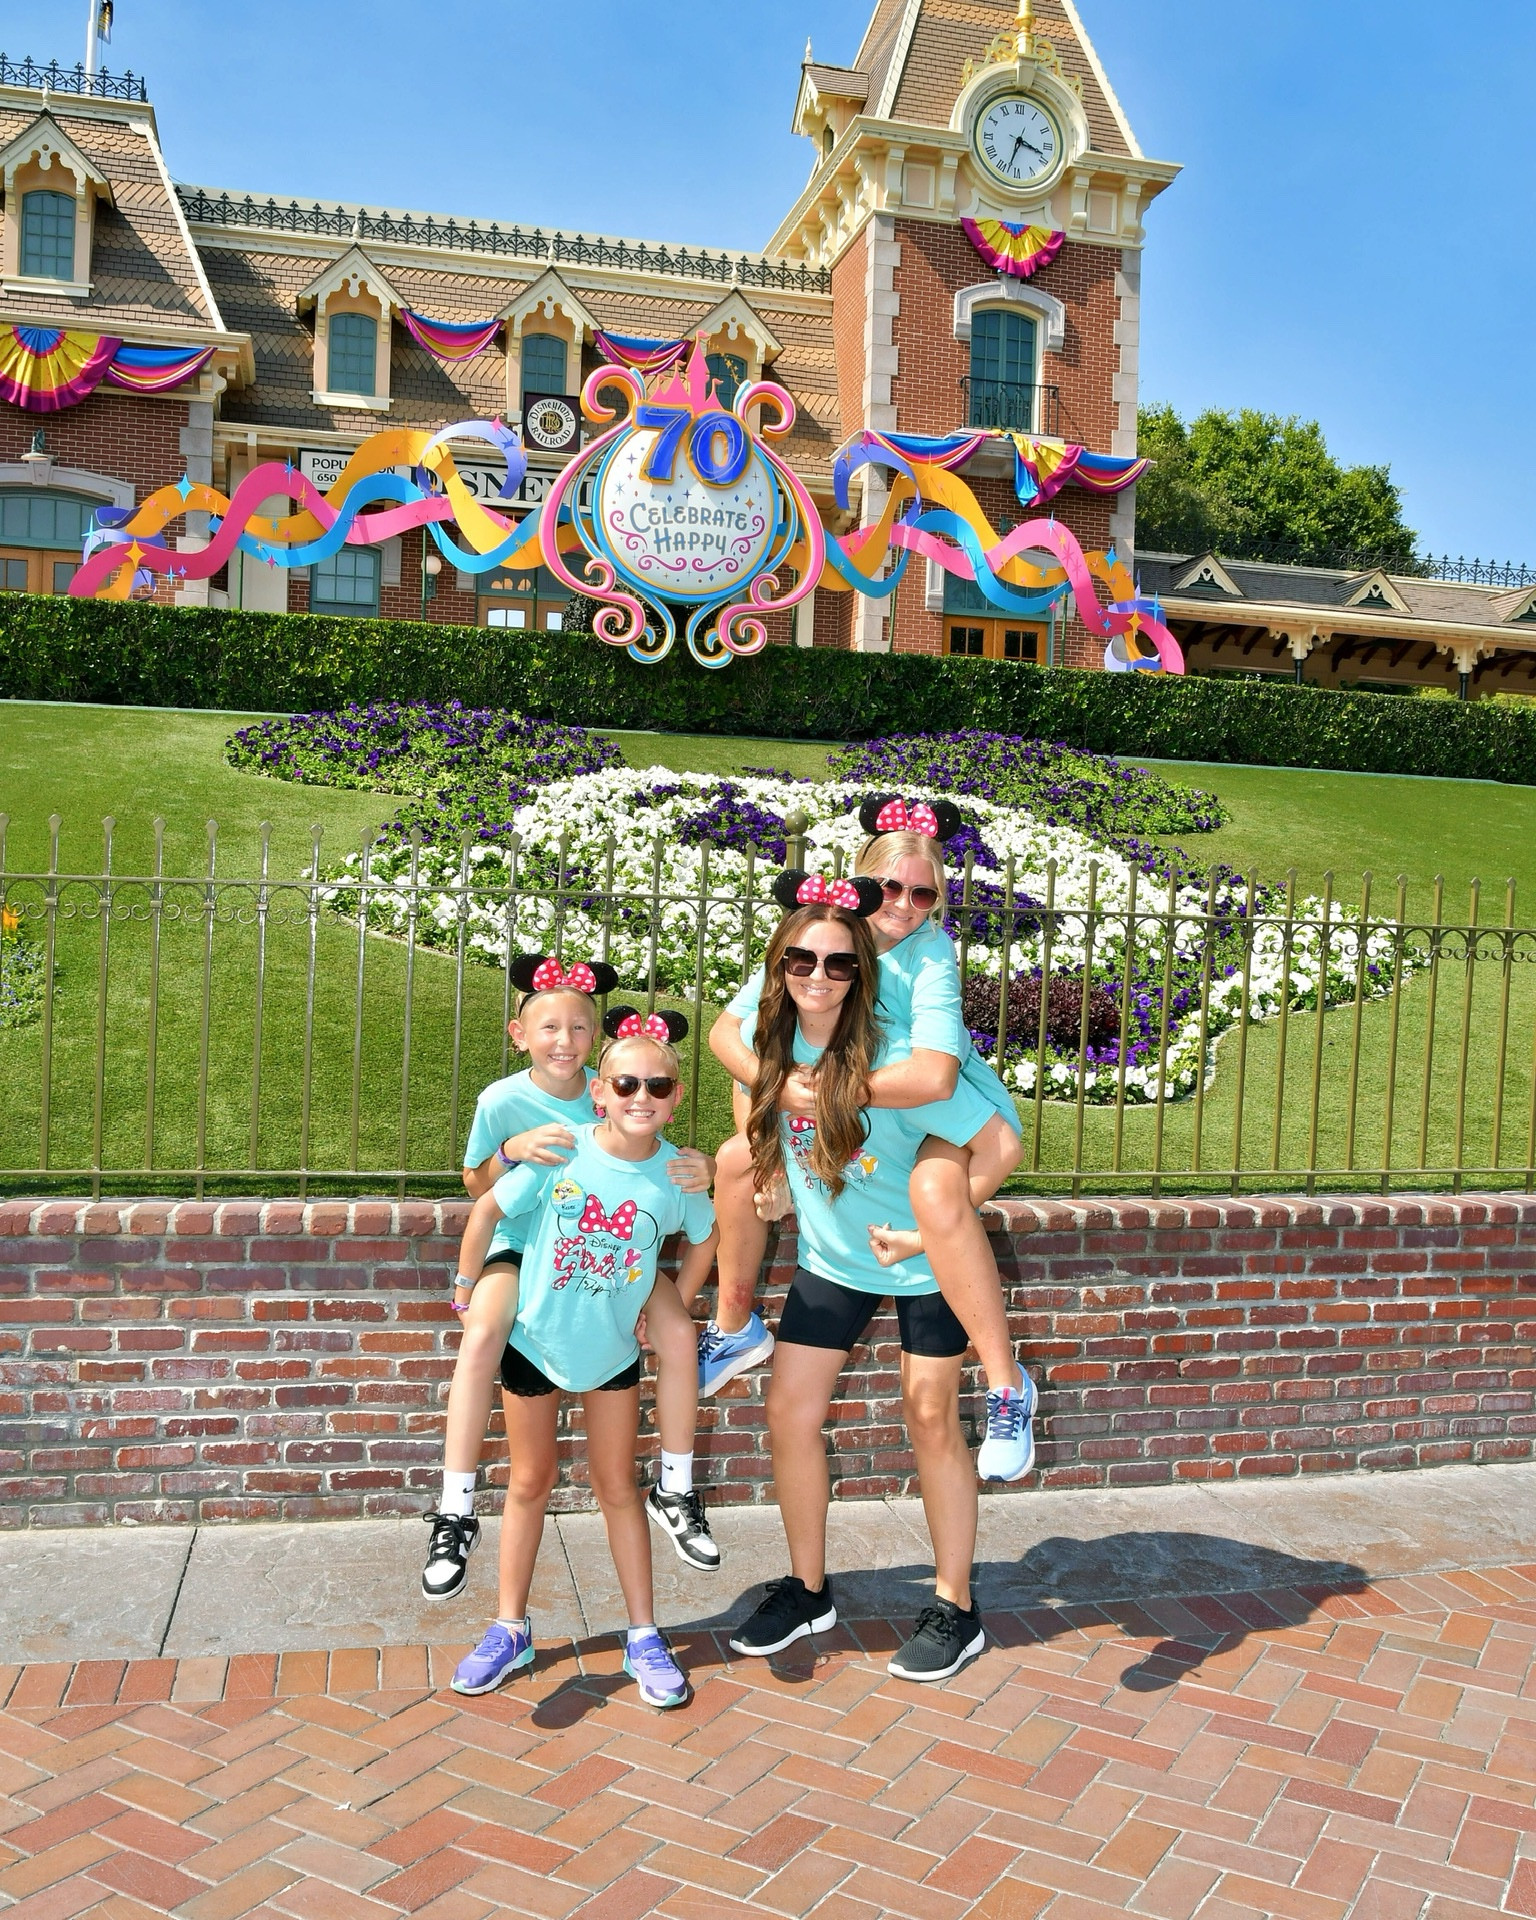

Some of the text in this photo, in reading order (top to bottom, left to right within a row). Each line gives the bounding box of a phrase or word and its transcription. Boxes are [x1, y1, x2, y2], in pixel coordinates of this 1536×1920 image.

[529, 401, 575, 423] Disneyland
[531, 426, 571, 446] RAILROAD
[634, 402, 751, 488] 70
